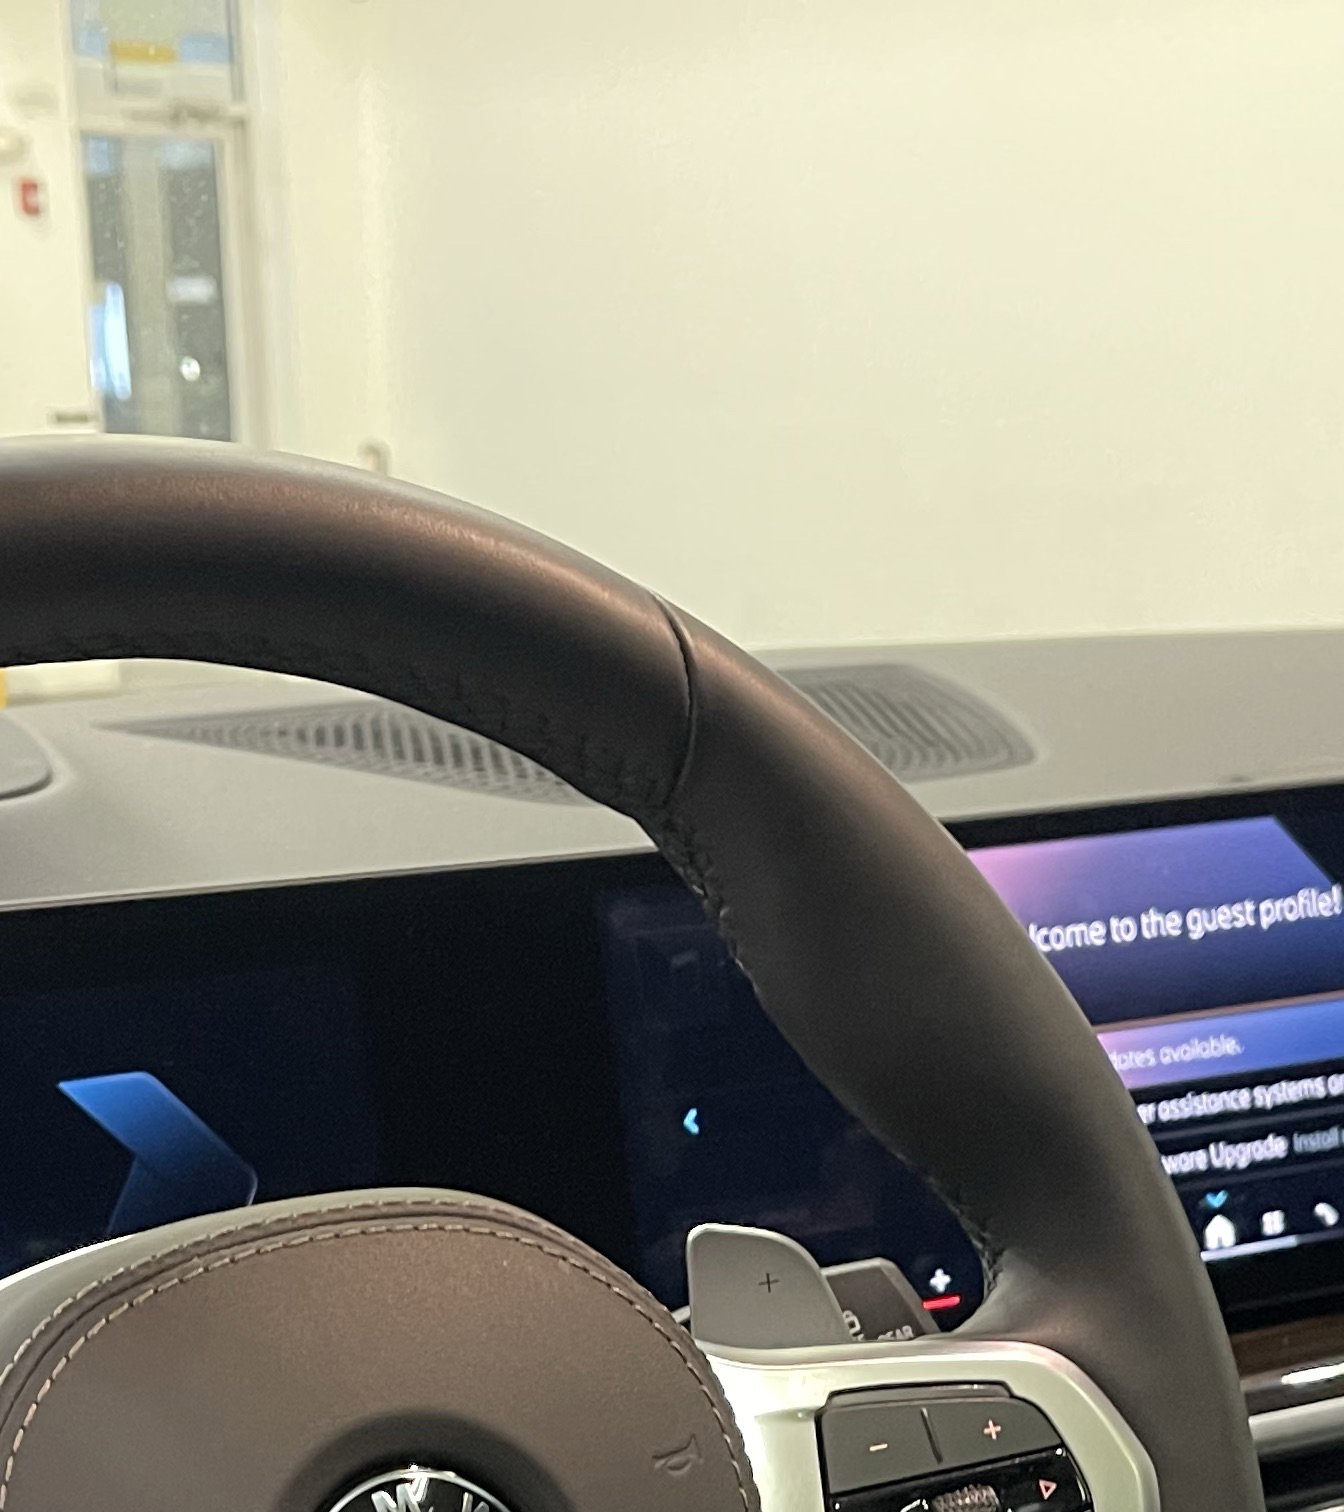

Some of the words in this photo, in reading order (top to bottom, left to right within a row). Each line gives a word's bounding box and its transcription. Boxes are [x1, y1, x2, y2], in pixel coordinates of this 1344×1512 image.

[1109, 915, 1138, 943] to
[1140, 908, 1183, 939] the
[1185, 899, 1257, 941] guest
[1259, 884, 1343, 930] profile!
[1157, 1089, 1253, 1122] assistance
[1253, 1076, 1328, 1110] systems
[1209, 1132, 1289, 1170] Upgrade
